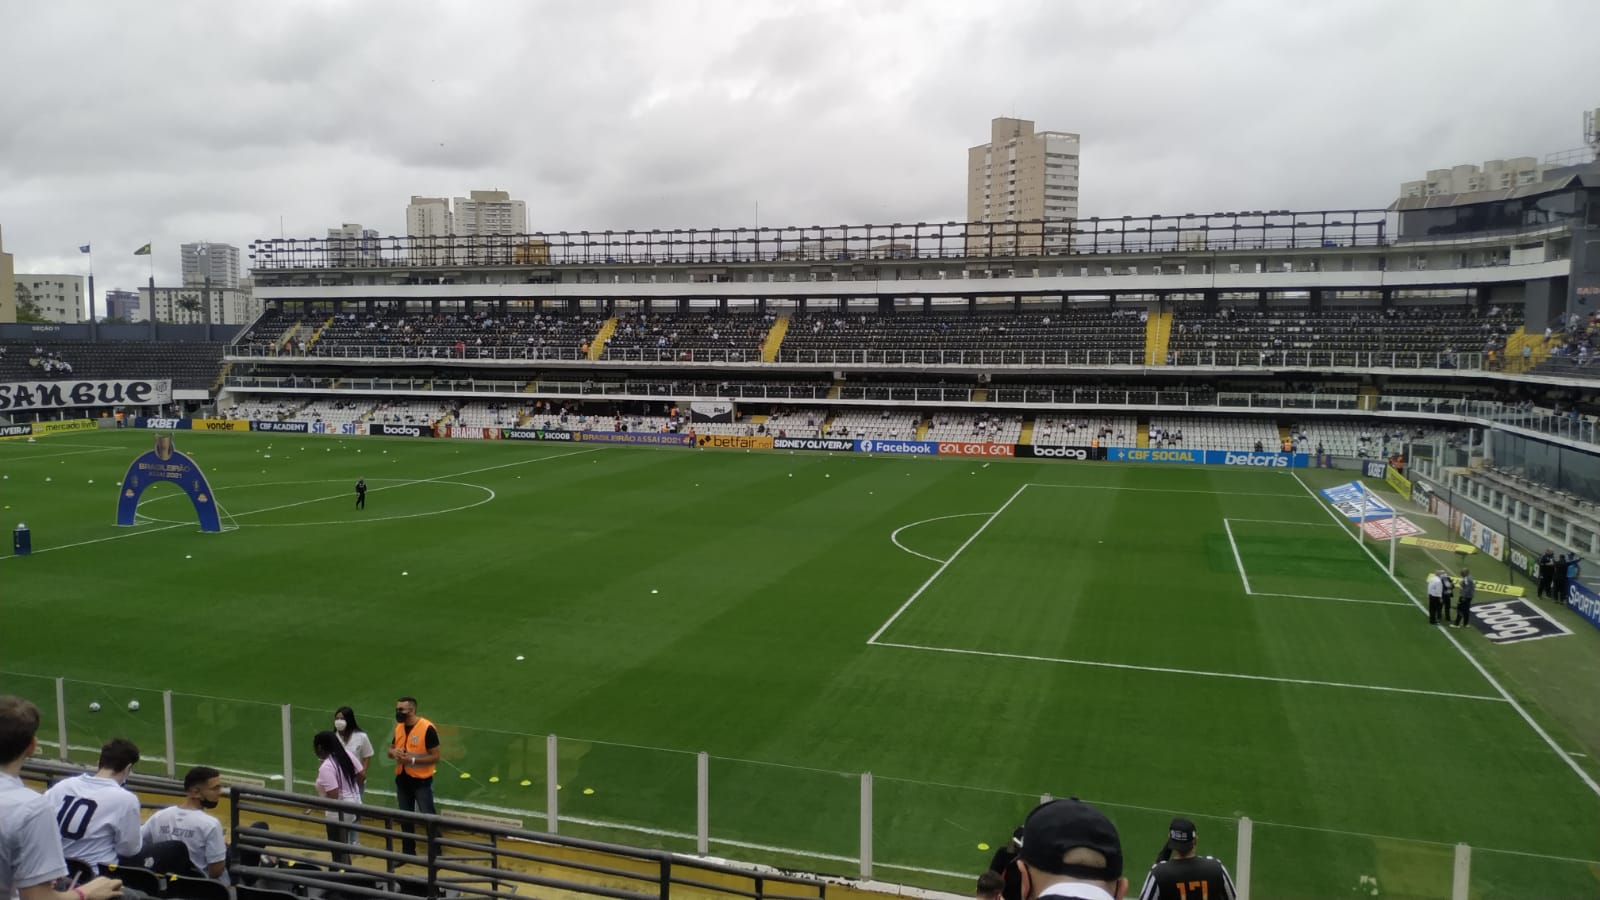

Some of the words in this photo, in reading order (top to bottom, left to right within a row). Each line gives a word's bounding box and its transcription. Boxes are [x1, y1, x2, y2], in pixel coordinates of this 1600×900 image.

[46, 422, 80, 431] mercado
[147, 418, 179, 429] 1XBET
[206, 422, 234, 431] vonder
[273, 423, 305, 432] ACADEMY
[383, 425, 420, 437] bodog
[451, 427, 484, 439] BRAHMA
[510, 430, 536, 439] SICOOB
[544, 431, 571, 440] SICOOB
[660, 436, 681, 444] 2021
[774, 438, 807, 449] SIDNEY
[876, 442, 931, 454] Facebook
[938, 443, 962, 454] GOL
[963, 444, 988, 456] GOL
[989, 445, 1013, 457] GOL
[1033, 445, 1087, 461] bodog
[1127, 450, 1150, 461] CBF
[1151, 450, 1196, 462] SOCIAL
[1224, 452, 1289, 468] betcris
[56, 794, 98, 840] 10
